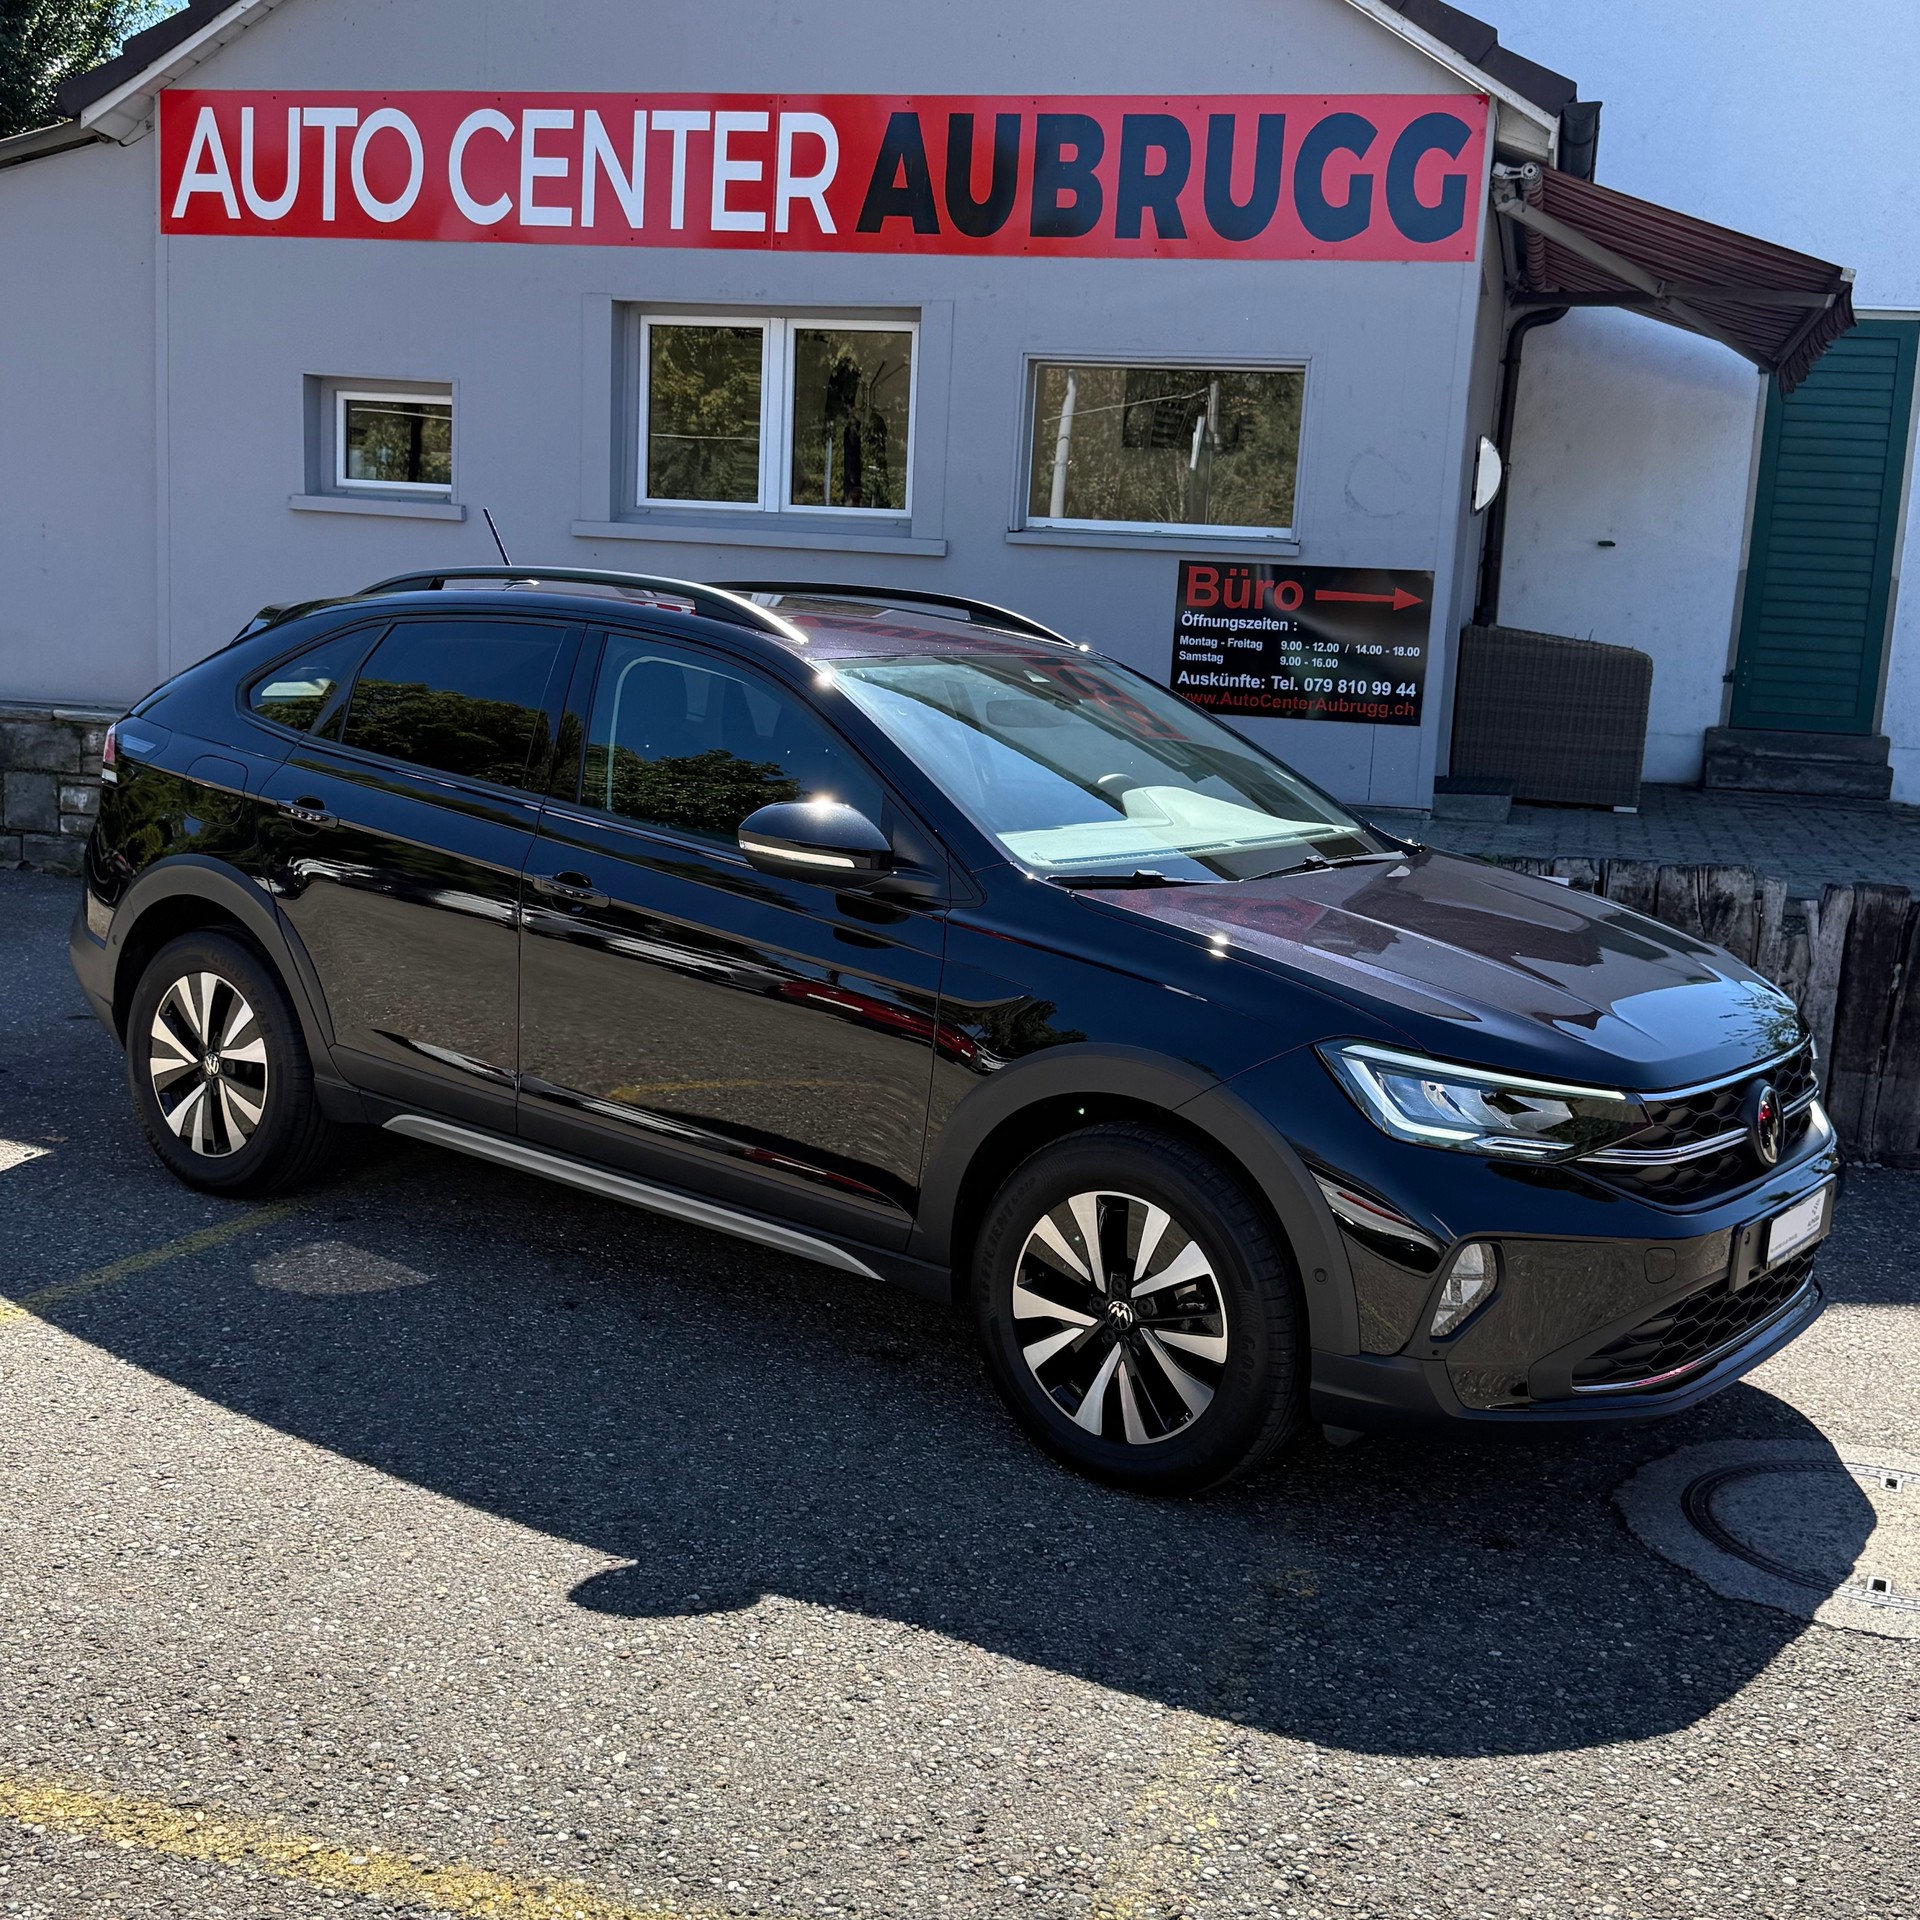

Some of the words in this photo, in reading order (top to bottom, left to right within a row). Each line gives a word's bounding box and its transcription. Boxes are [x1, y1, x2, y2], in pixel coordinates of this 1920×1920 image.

[171, 106, 424, 223] AUTO
[448, 108, 839, 234] CENTER
[855, 111, 1473, 243] AUBRUGG
[1185, 565, 1304, 611] Büro
[1181, 610, 1289, 631] Öffnungszeiten
[1179, 635, 1218, 649] Montag
[1227, 637, 1263, 651] Freitag
[1280, 640, 1303, 651] 9.00
[1312, 642, 1340, 653] 12.00
[1355, 644, 1383, 655] 14.00
[1392, 646, 1420, 657] 18.00
[1178, 650, 1224, 665] Samstag
[1279, 656, 1302, 667] 9.00
[1311, 657, 1339, 669] 16.00
[1177, 670, 1266, 689] Auskünfte:
[1270, 675, 1299, 691] Tel.
[1303, 677, 1333, 693] 079
[1337, 679, 1367, 695] 810
[1371, 681, 1392, 696] 99
[1395, 682, 1417, 698] 44
